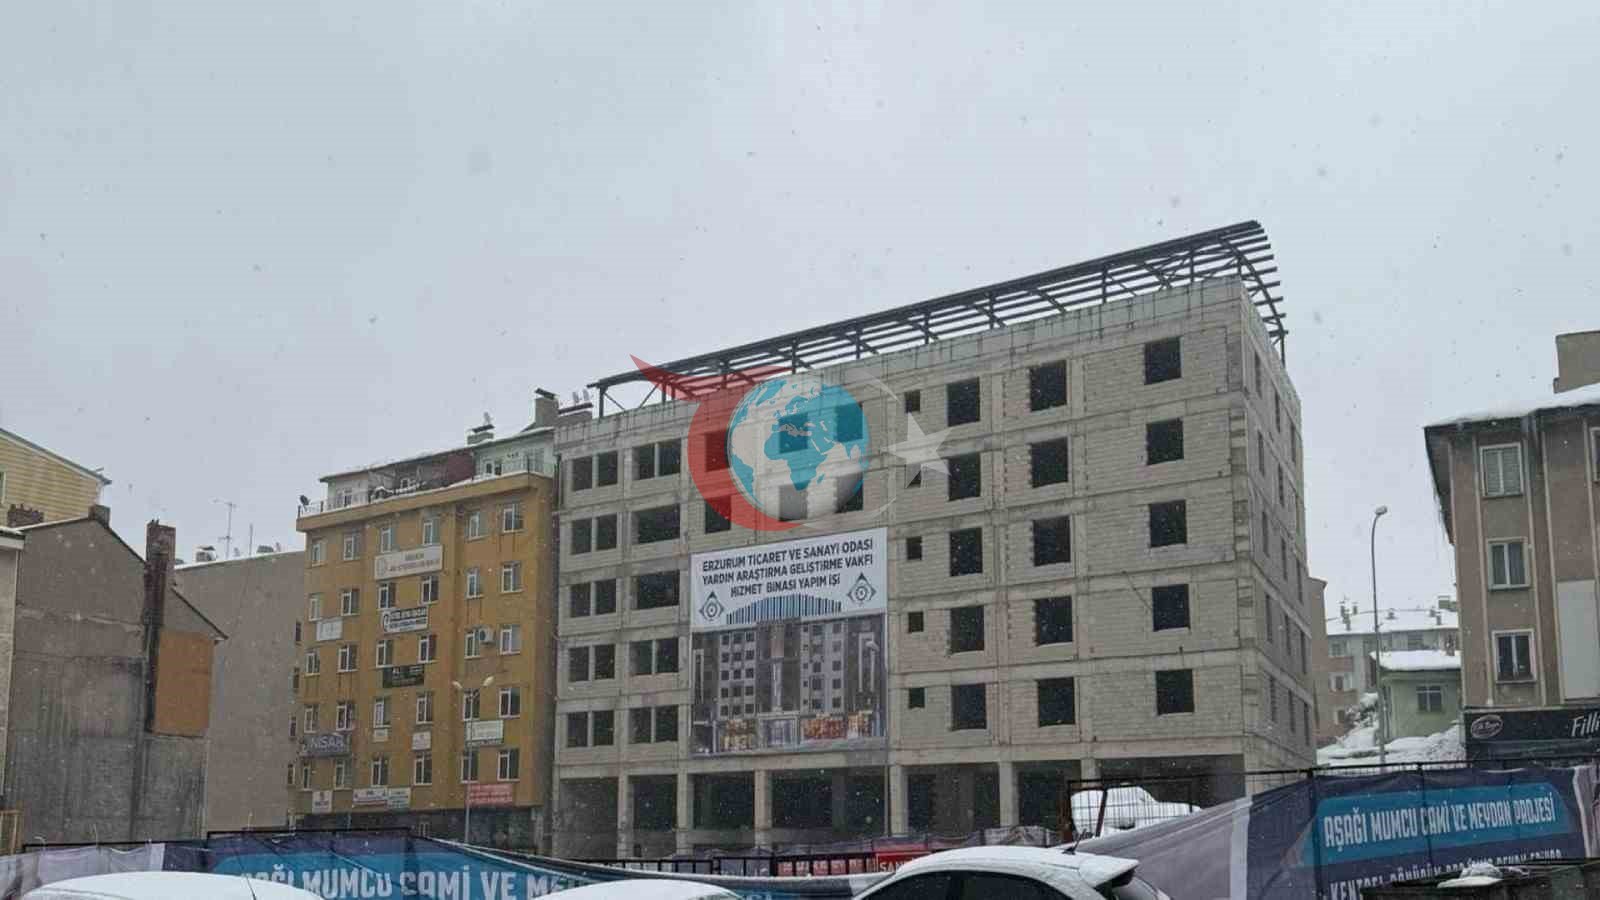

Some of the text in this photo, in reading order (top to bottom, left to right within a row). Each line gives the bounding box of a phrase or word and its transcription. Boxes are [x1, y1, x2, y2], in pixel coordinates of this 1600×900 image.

[702, 556, 746, 572] ERZURUM
[788, 549, 801, 561] VE
[798, 576, 827, 589] YAPIM
[1323, 792, 1556, 852] AŞAĞI MUMCU CAMİ VE MEYDAN PROJESİ
[303, 868, 393, 899] MUMCU
[400, 865, 471, 900] CAMİ
[480, 871, 517, 900] VE
